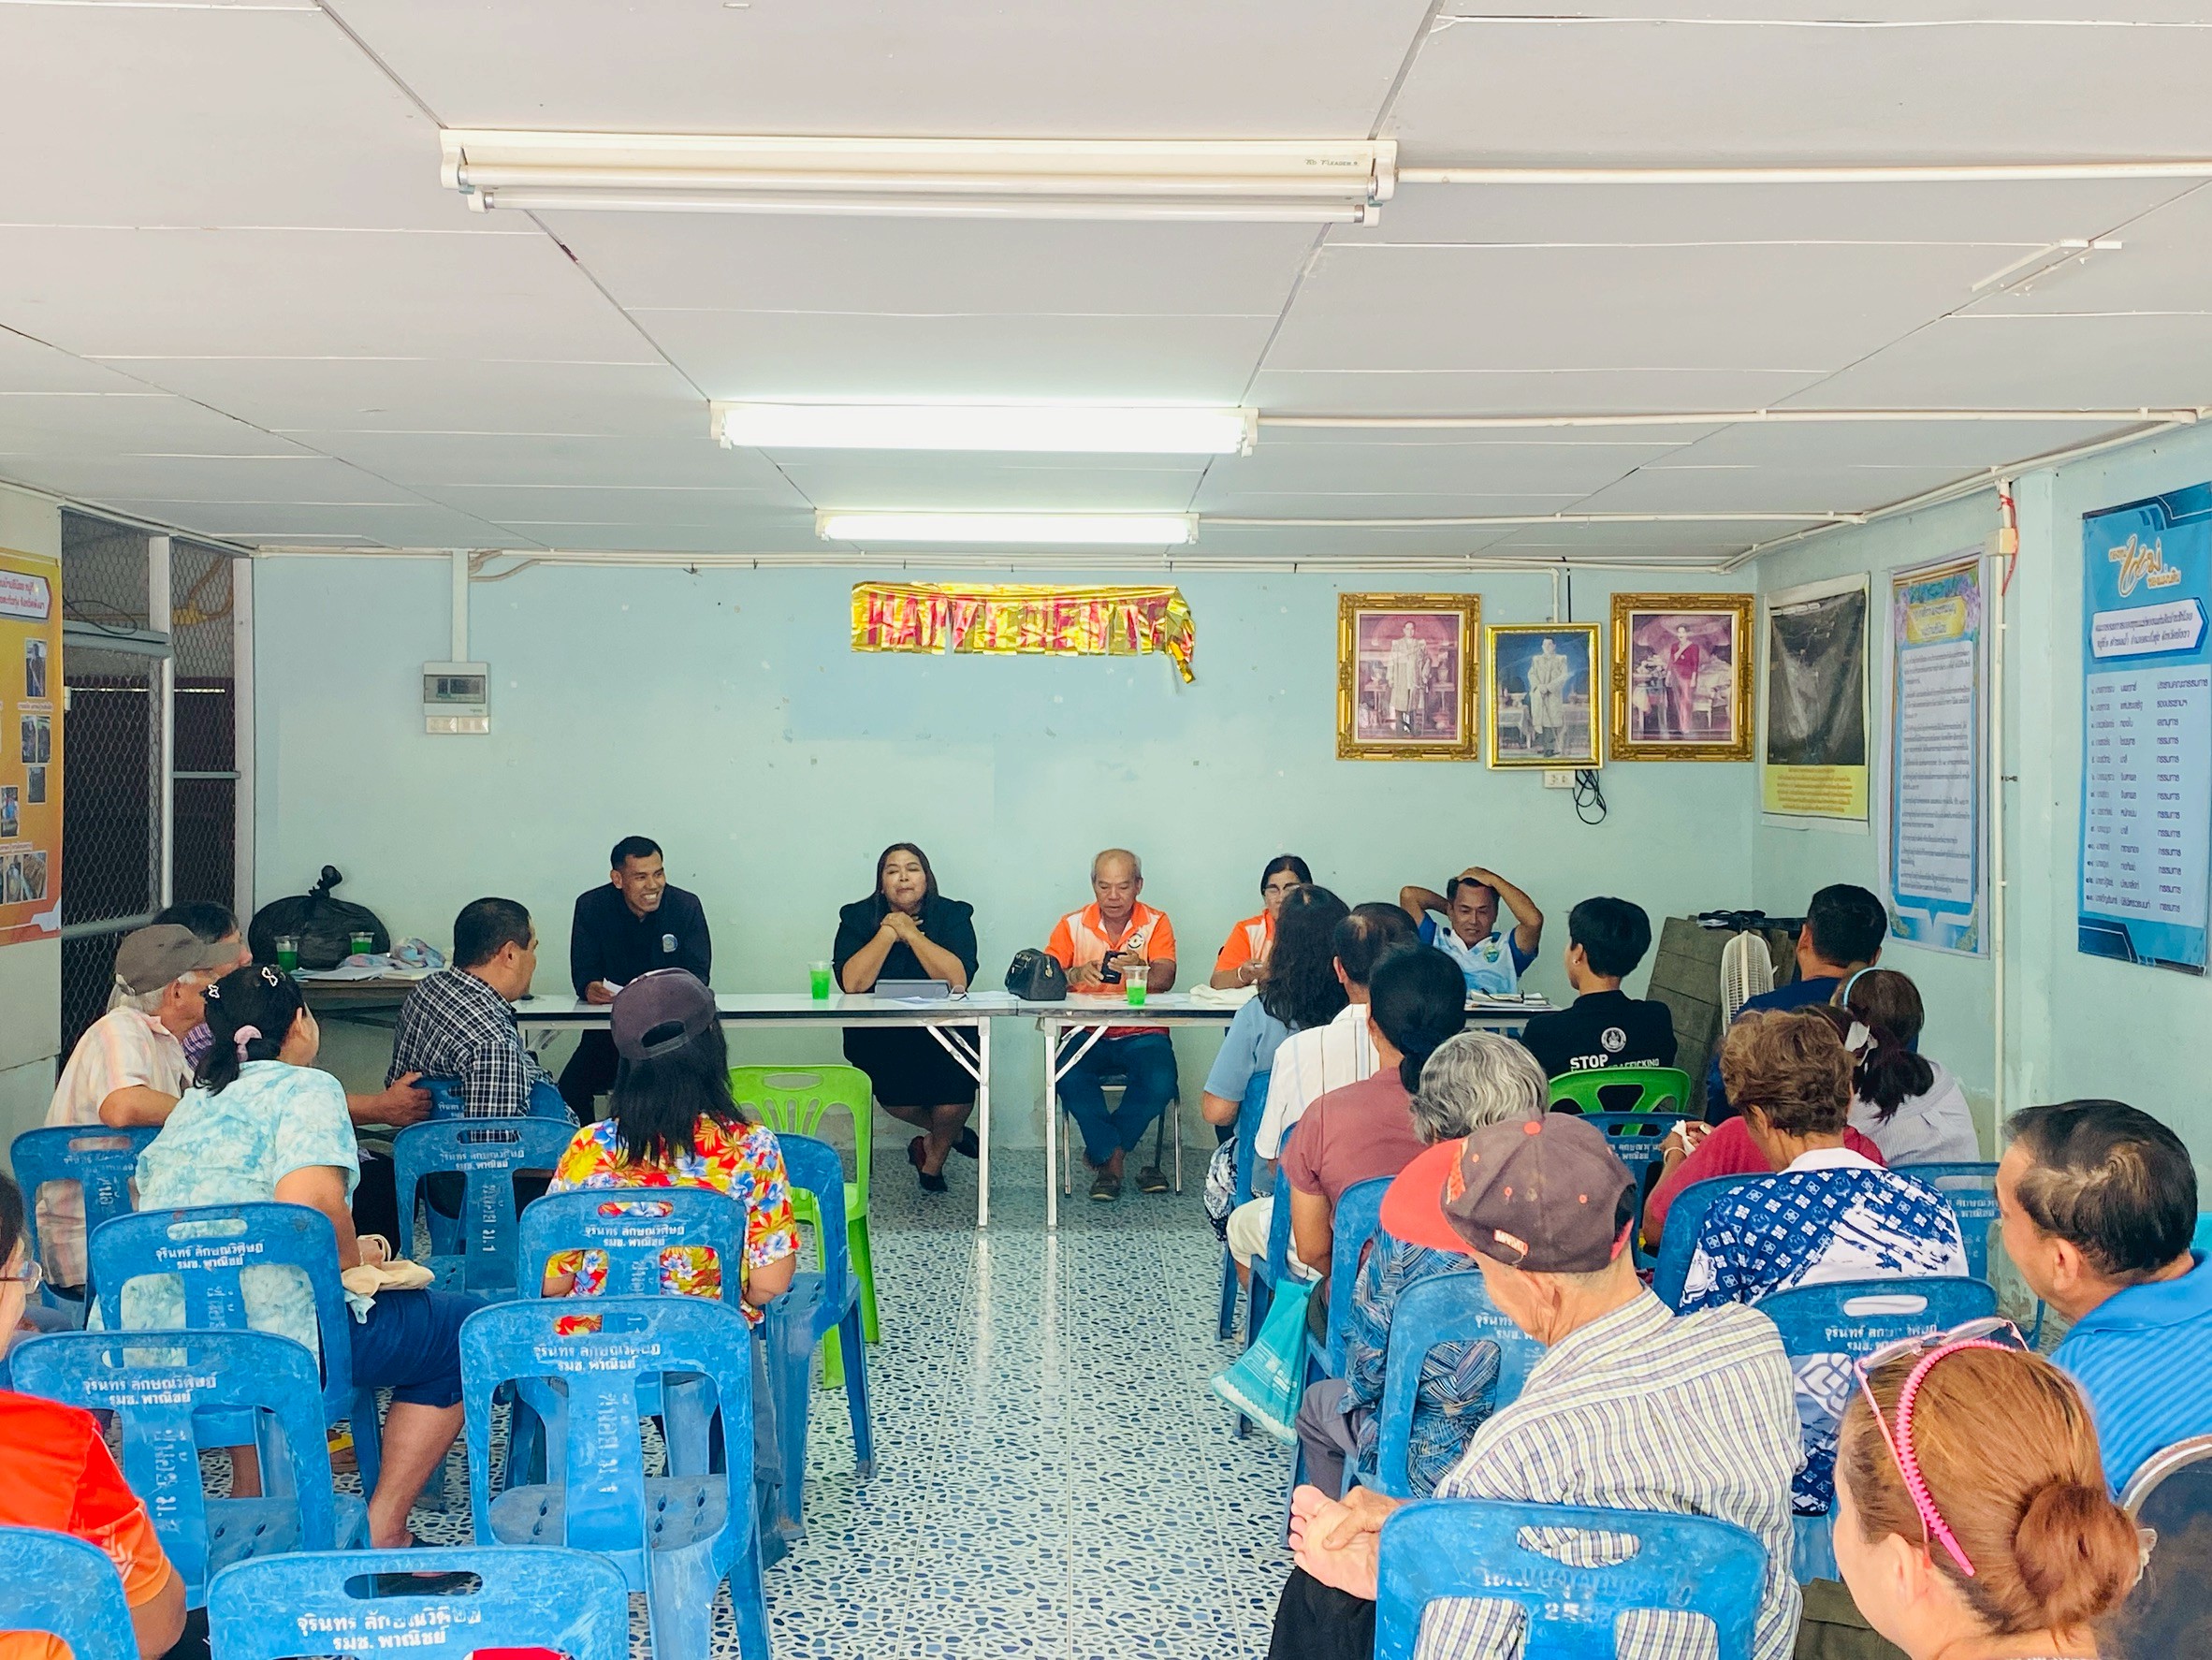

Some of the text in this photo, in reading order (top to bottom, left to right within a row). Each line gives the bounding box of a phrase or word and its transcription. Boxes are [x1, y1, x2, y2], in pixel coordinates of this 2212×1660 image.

[1569, 1054, 1608, 1070] STOP
[140, 1388, 194, 1405] พาณิชย์
[332, 1624, 450, 1651] รมช. พาณิชย์
